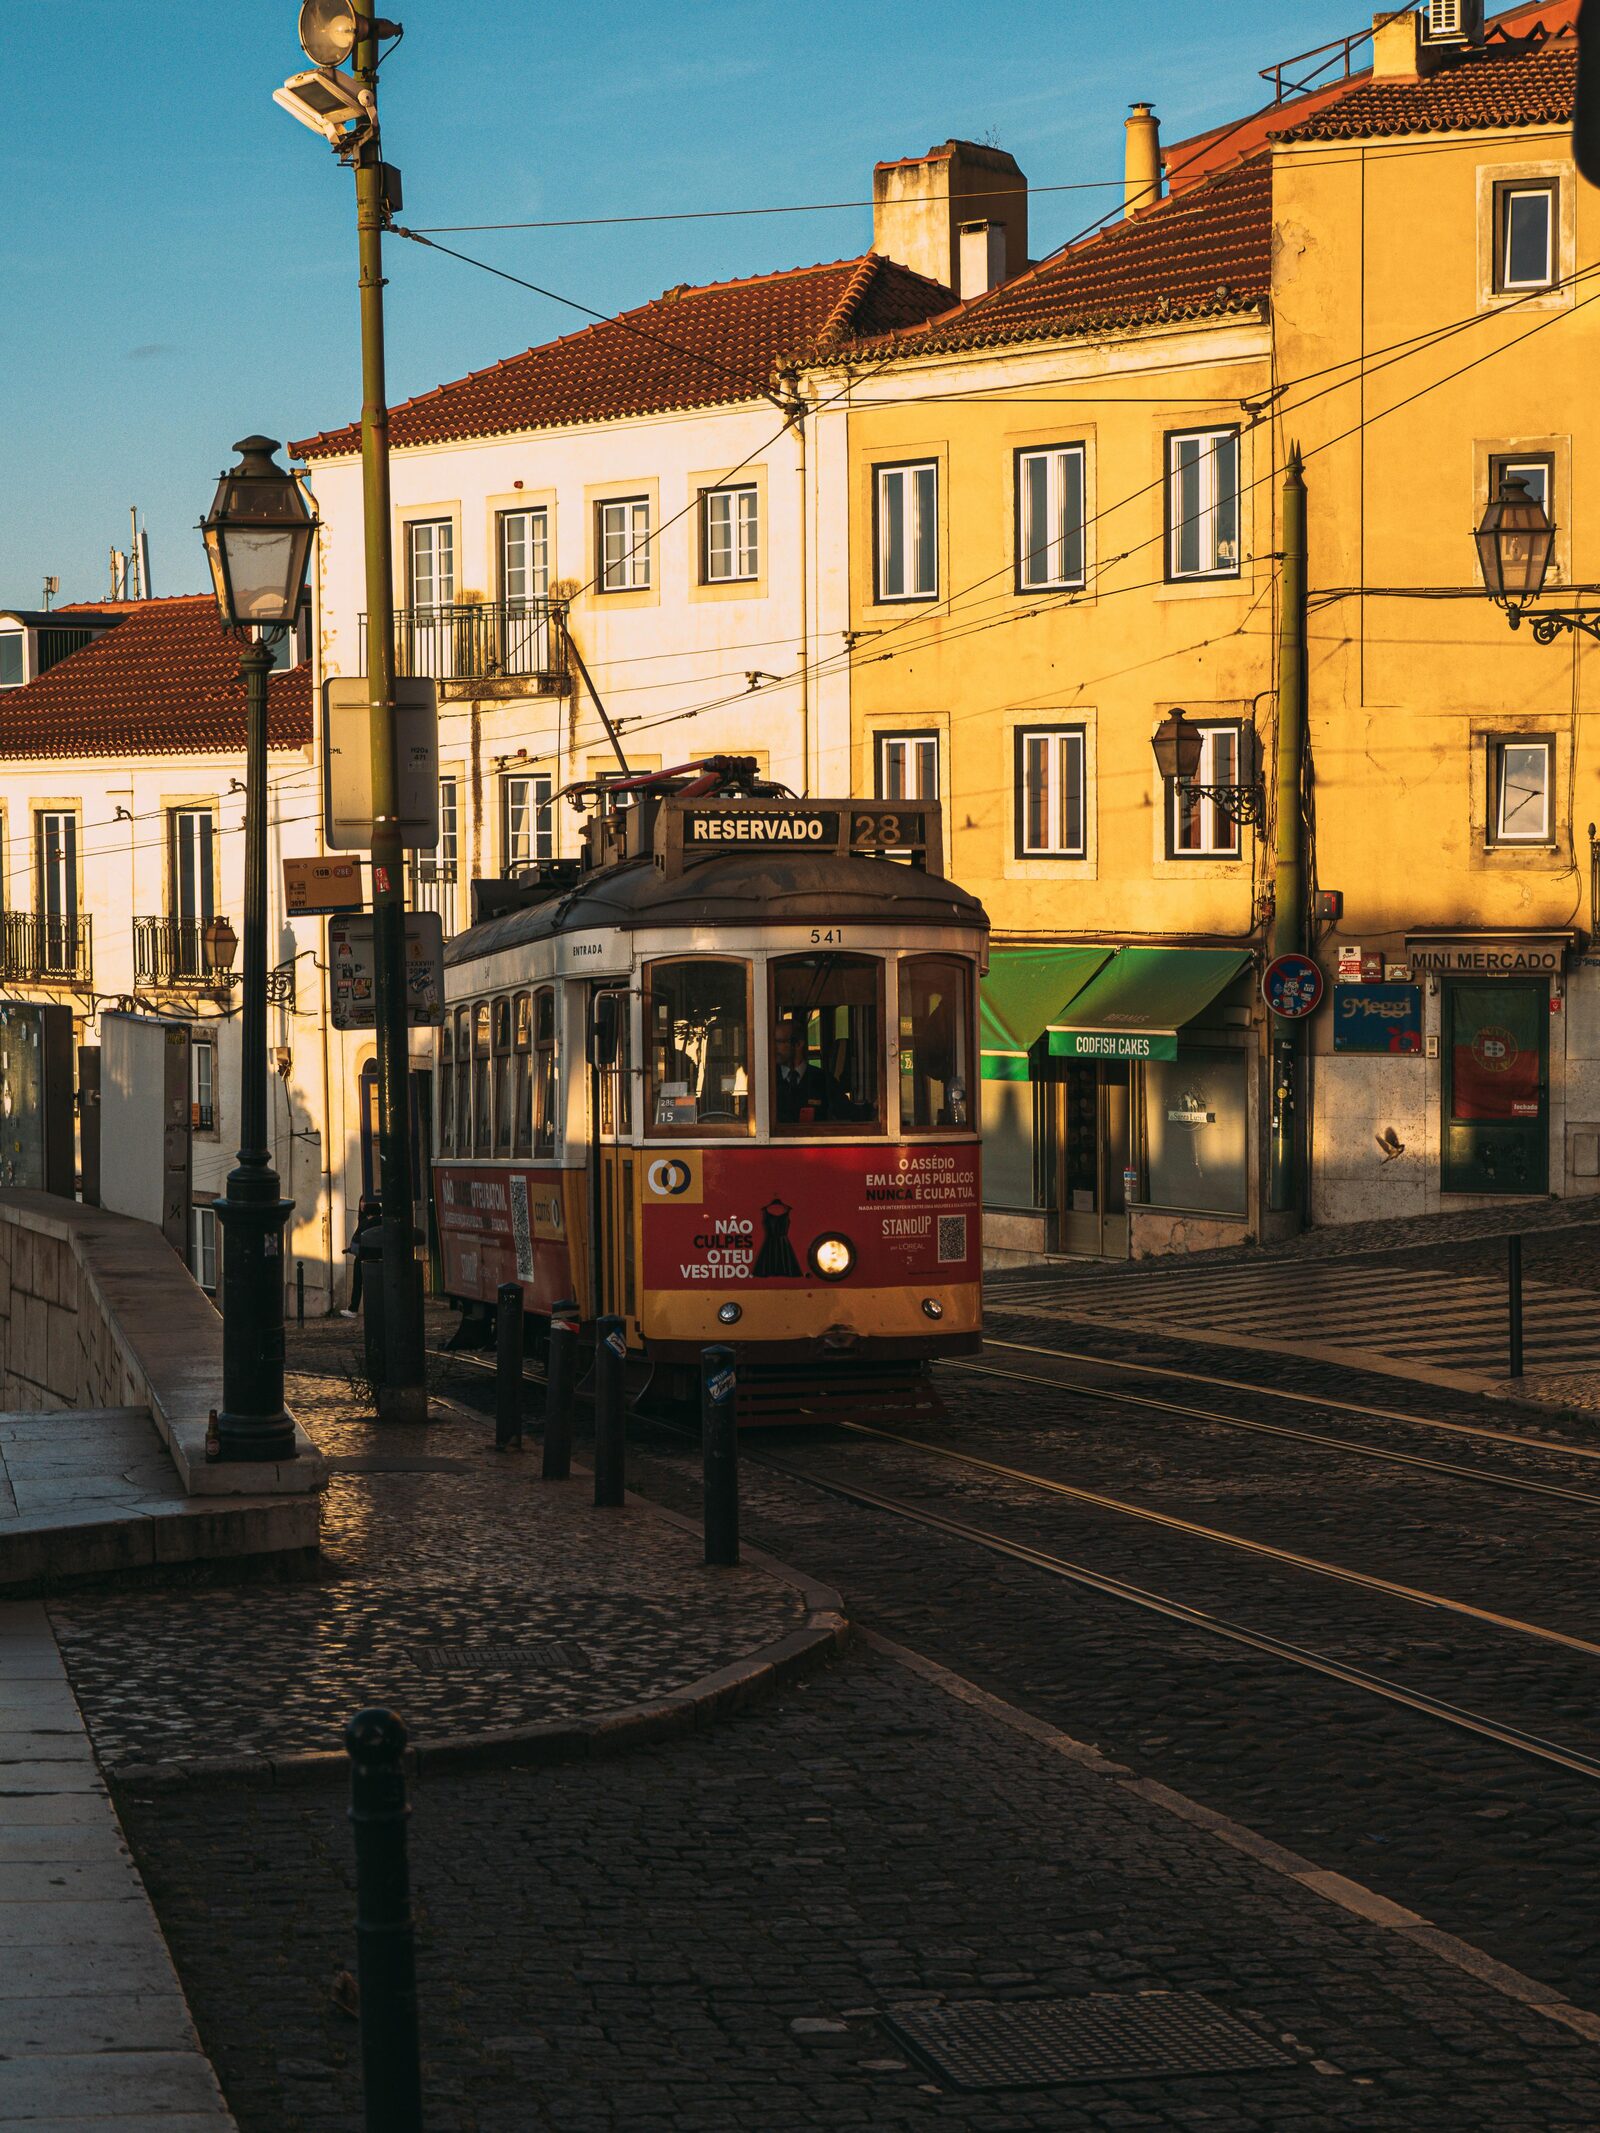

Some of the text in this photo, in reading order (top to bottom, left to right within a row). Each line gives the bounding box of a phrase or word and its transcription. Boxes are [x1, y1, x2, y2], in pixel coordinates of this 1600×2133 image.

[693, 819, 824, 840] RESERVADO
[855, 815, 901, 844] 28
[315, 869, 330, 877] 10B
[810, 929, 843, 945] 541
[573, 944, 603, 956] ENTRADA
[1412, 953, 1556, 969] MINI MERCADO
[1076, 1036, 1150, 1056] CODFISH CAKES
[660, 1099, 675, 1107] 28E
[660, 1112, 674, 1122] 15
[899, 1154, 955, 1170] O ASSÉDIO
[865, 1169, 974, 1186] EM LOCAIS PÚBLICOS
[866, 1185, 975, 1200] NUNCA É CULPA TUA.
[715, 1215, 753, 1235] NÃO
[882, 1215, 932, 1235] STANDUP
[693, 1235, 753, 1249] CULPES
[707, 1250, 753, 1264] O TEU
[679, 1264, 754, 1279] VESTIDO.
